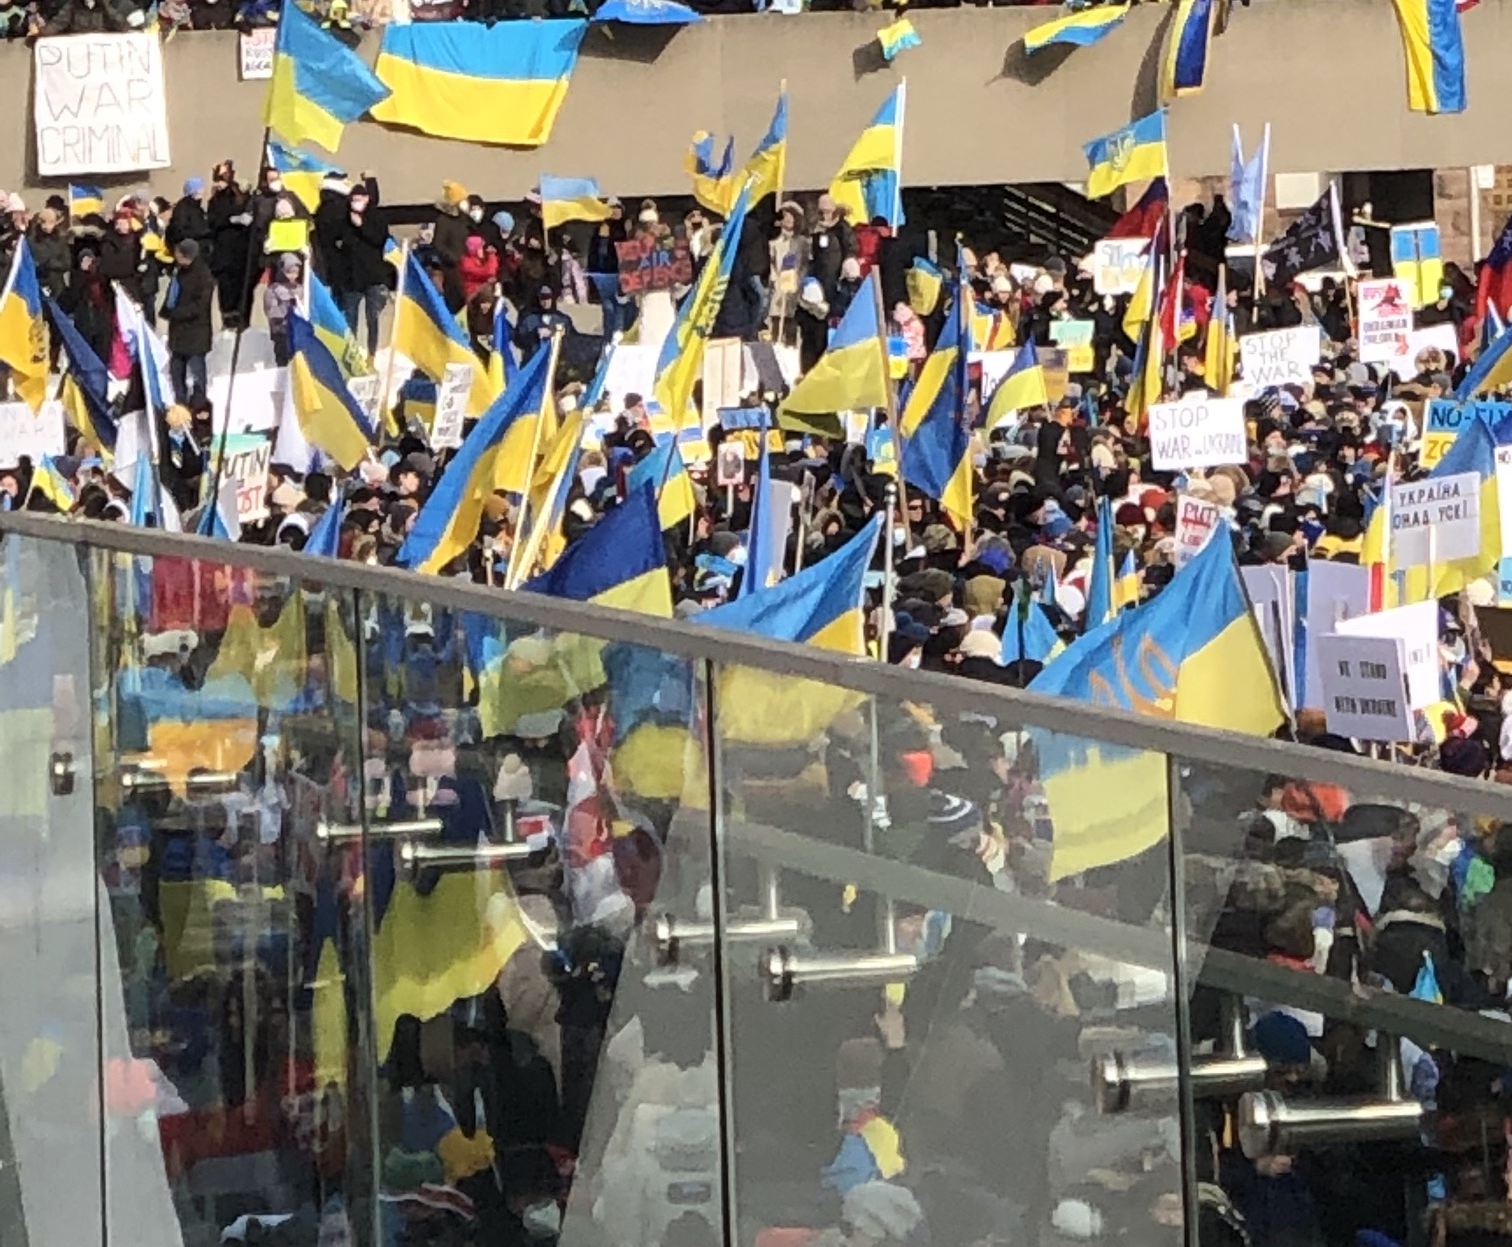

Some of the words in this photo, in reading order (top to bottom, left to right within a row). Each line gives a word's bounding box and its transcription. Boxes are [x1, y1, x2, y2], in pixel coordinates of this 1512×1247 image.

[38, 40, 150, 79] PUTIN
[44, 78, 152, 121] WAR
[40, 124, 167, 165] CRIMINAL
[1246, 331, 1297, 355] STOP
[1259, 350, 1287, 365] THE
[1251, 361, 1302, 385] WAR
[1156, 405, 1209, 431] STOP
[1156, 434, 1192, 460] WAR
[221, 445, 269, 479] UTIN
[1399, 482, 1461, 507] УКРАЇНА
[1391, 509, 1430, 529] ОНАД
[1338, 660, 1351, 678] WE
[1359, 660, 1387, 680] STAND
[1334, 696, 1357, 714] WITH
[1358, 697, 1397, 719] UKRAINE
